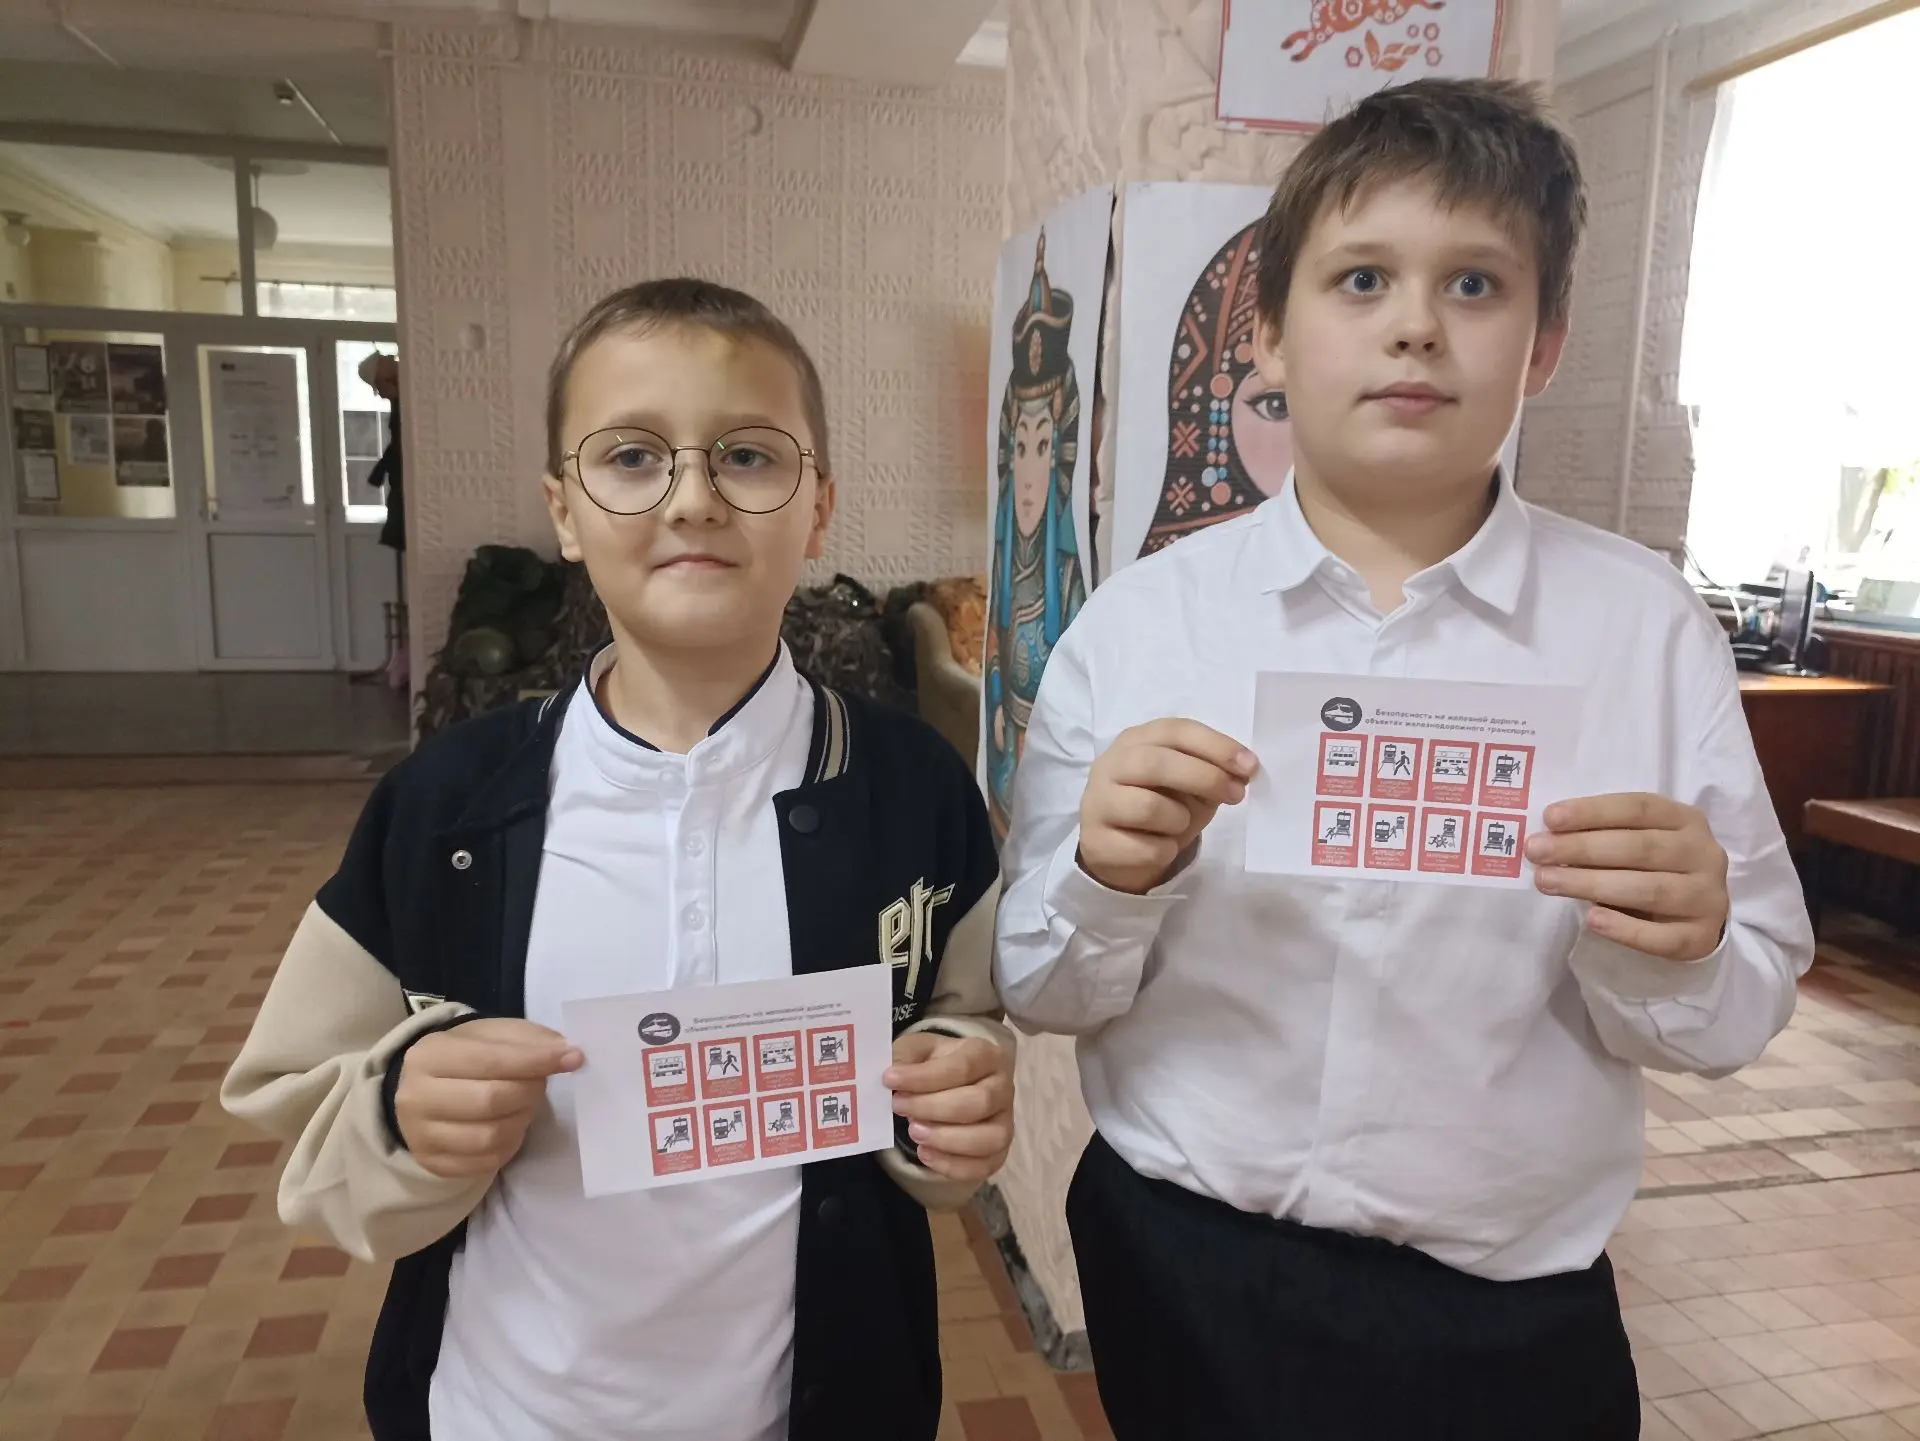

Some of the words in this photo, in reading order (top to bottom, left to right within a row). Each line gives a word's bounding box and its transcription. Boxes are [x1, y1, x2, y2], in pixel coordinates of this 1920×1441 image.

[1375, 708, 1433, 719] Безопасность
[1447, 714, 1488, 723] железной
[1405, 721, 1485, 732] железнодорожного
